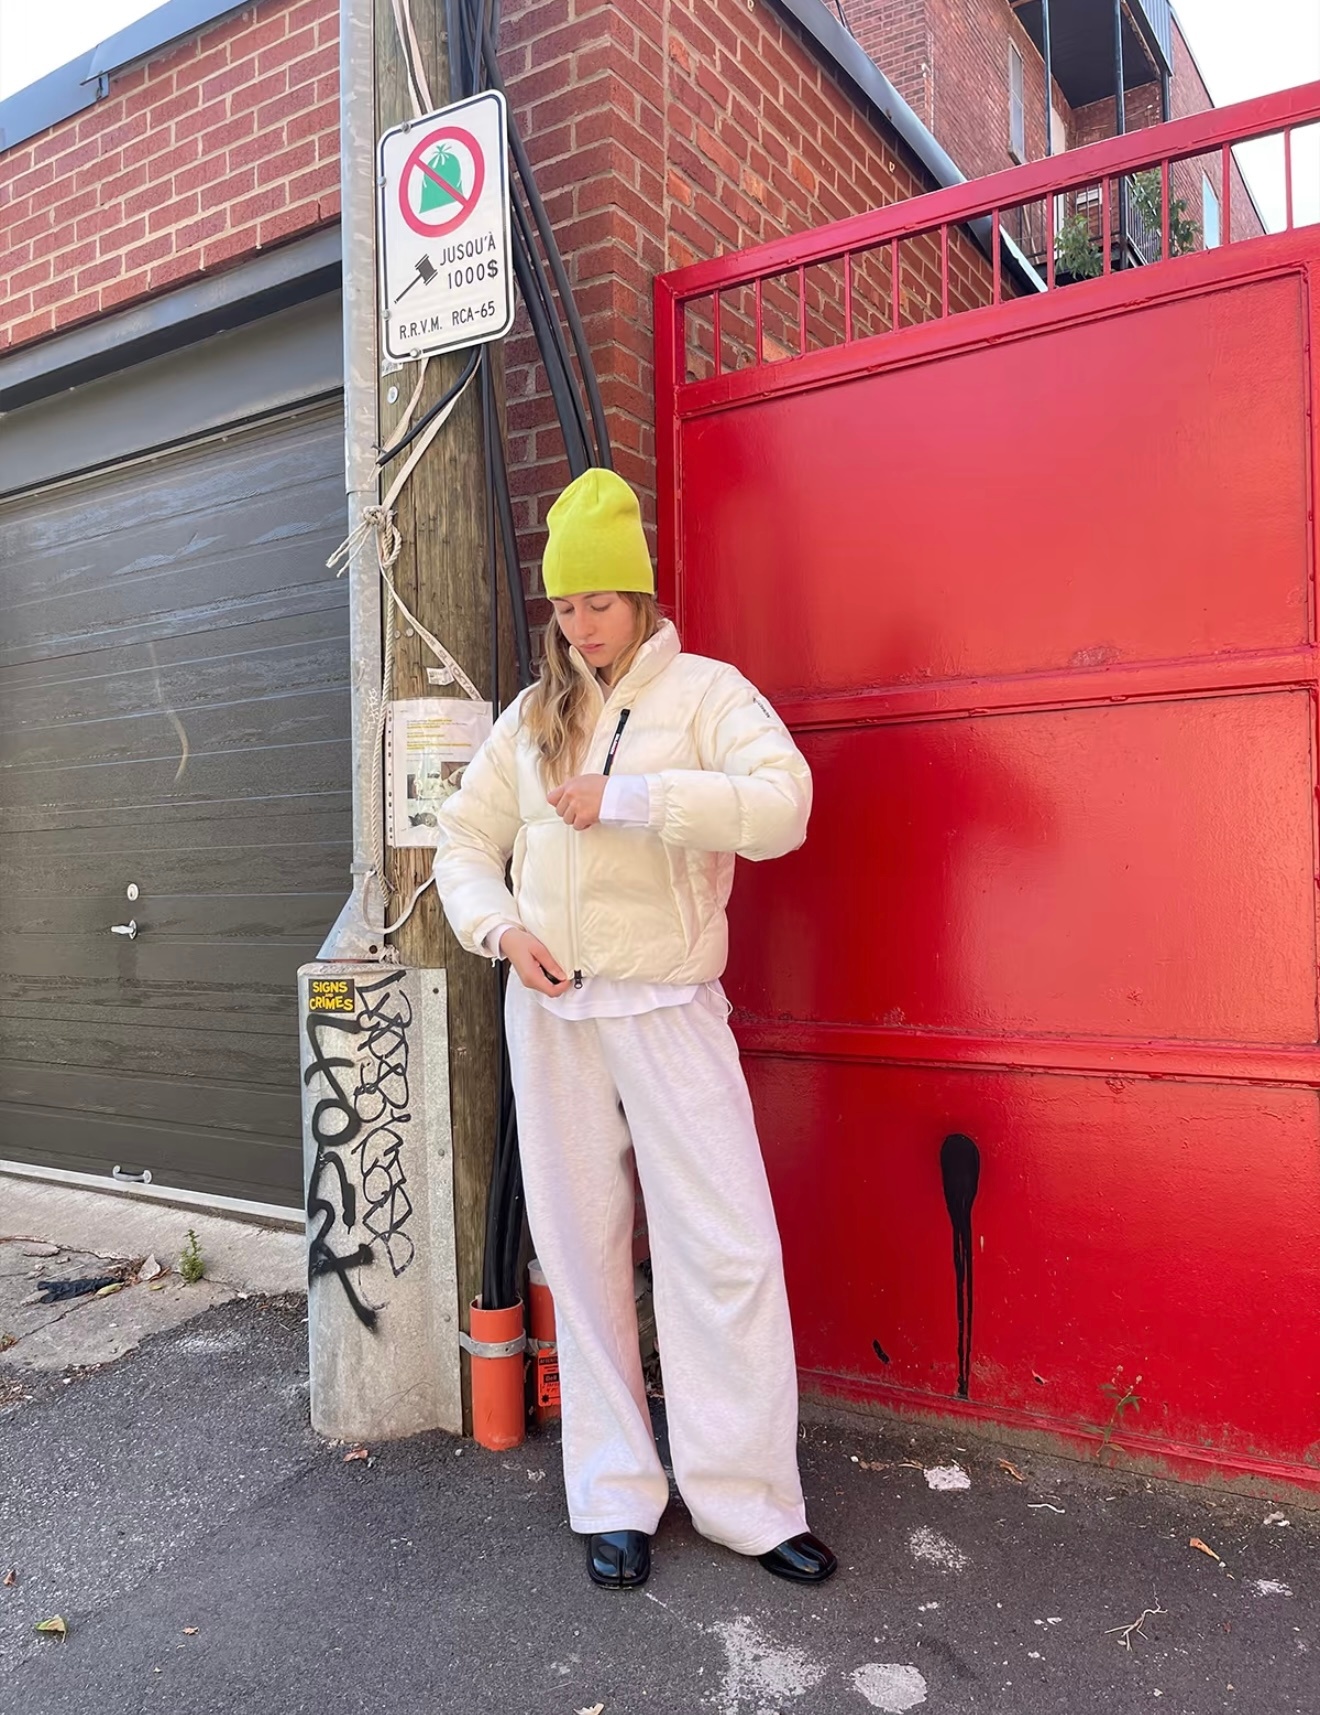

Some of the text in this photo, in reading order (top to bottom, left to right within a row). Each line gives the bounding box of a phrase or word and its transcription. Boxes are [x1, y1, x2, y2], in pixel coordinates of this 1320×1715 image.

[439, 231, 496, 266] JUSQU'À
[447, 259, 499, 290] 1000$
[399, 300, 496, 340] R.R.V.M. RCA-65
[312, 981, 348, 993] SIGNS
[309, 995, 354, 1011] CRIMES
